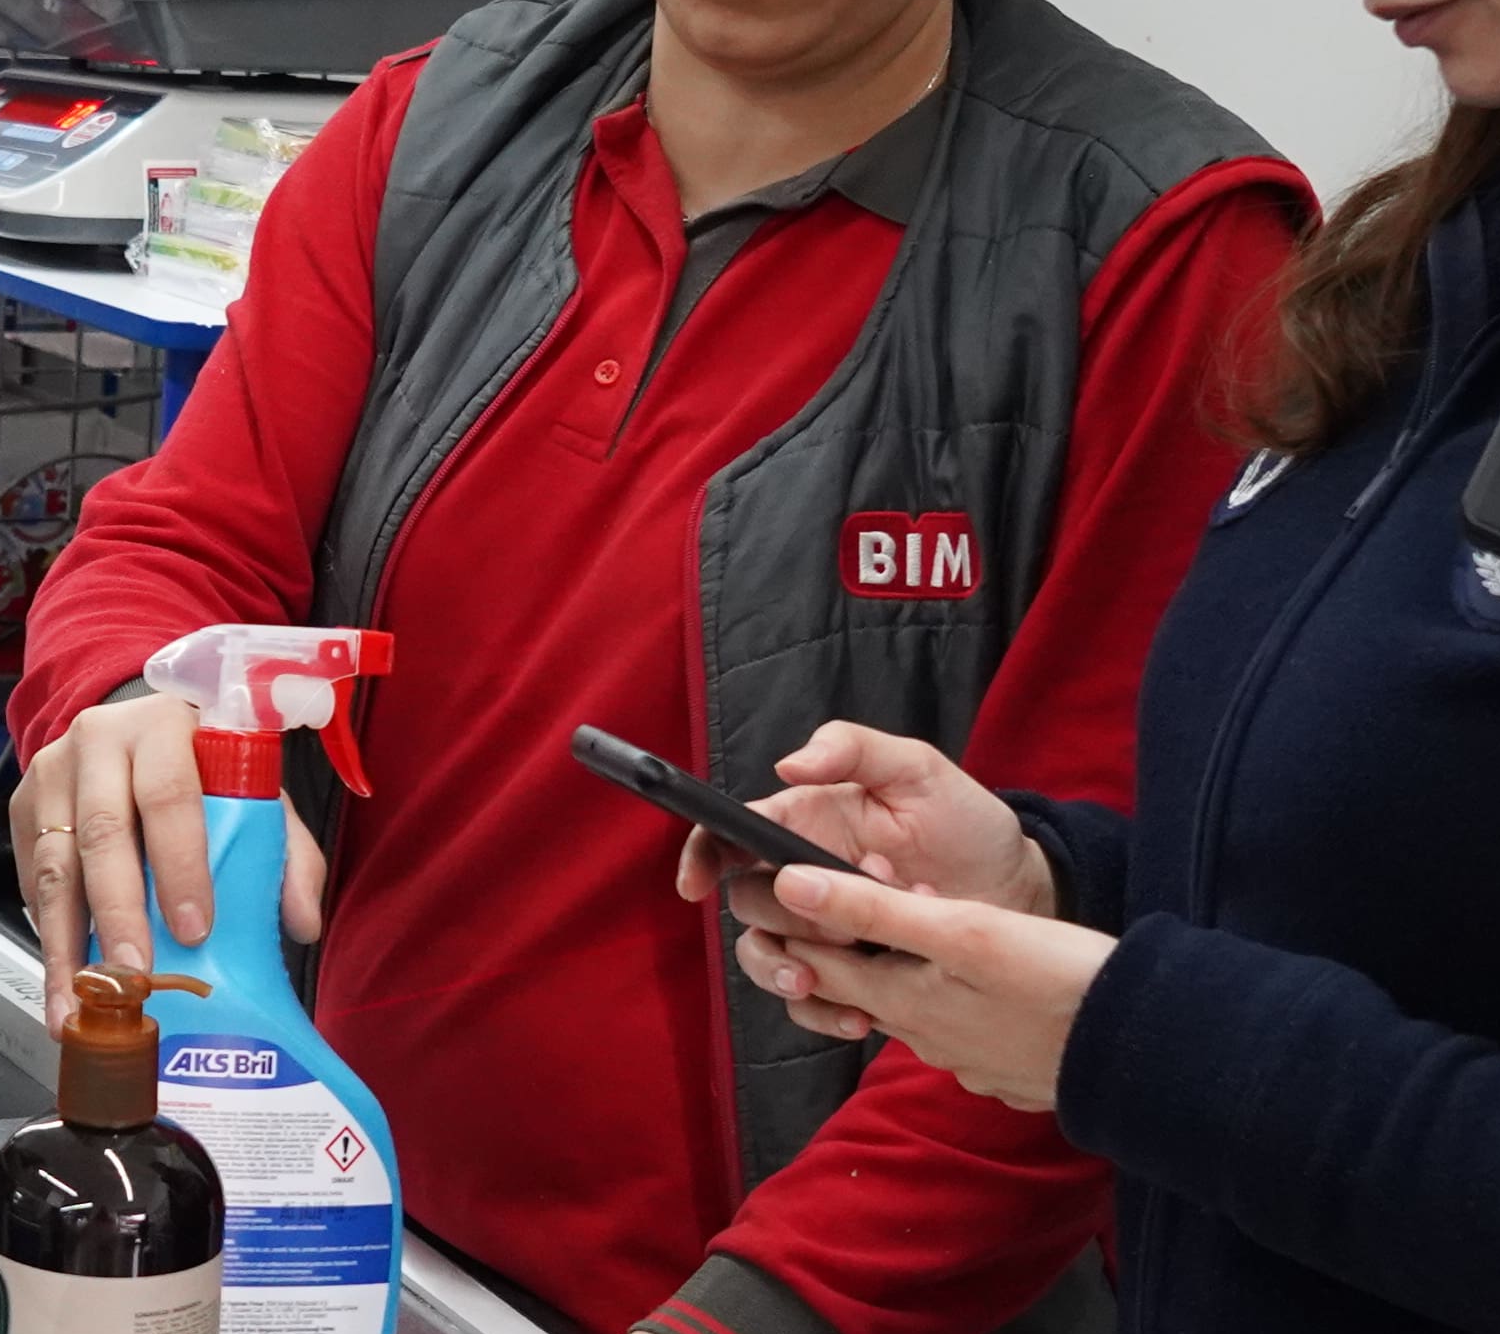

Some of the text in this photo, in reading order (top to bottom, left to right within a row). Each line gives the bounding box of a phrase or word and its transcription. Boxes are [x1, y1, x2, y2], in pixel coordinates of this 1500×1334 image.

[858, 531, 972, 588] BIM
[171, 1051, 273, 1075] AKS Bril
